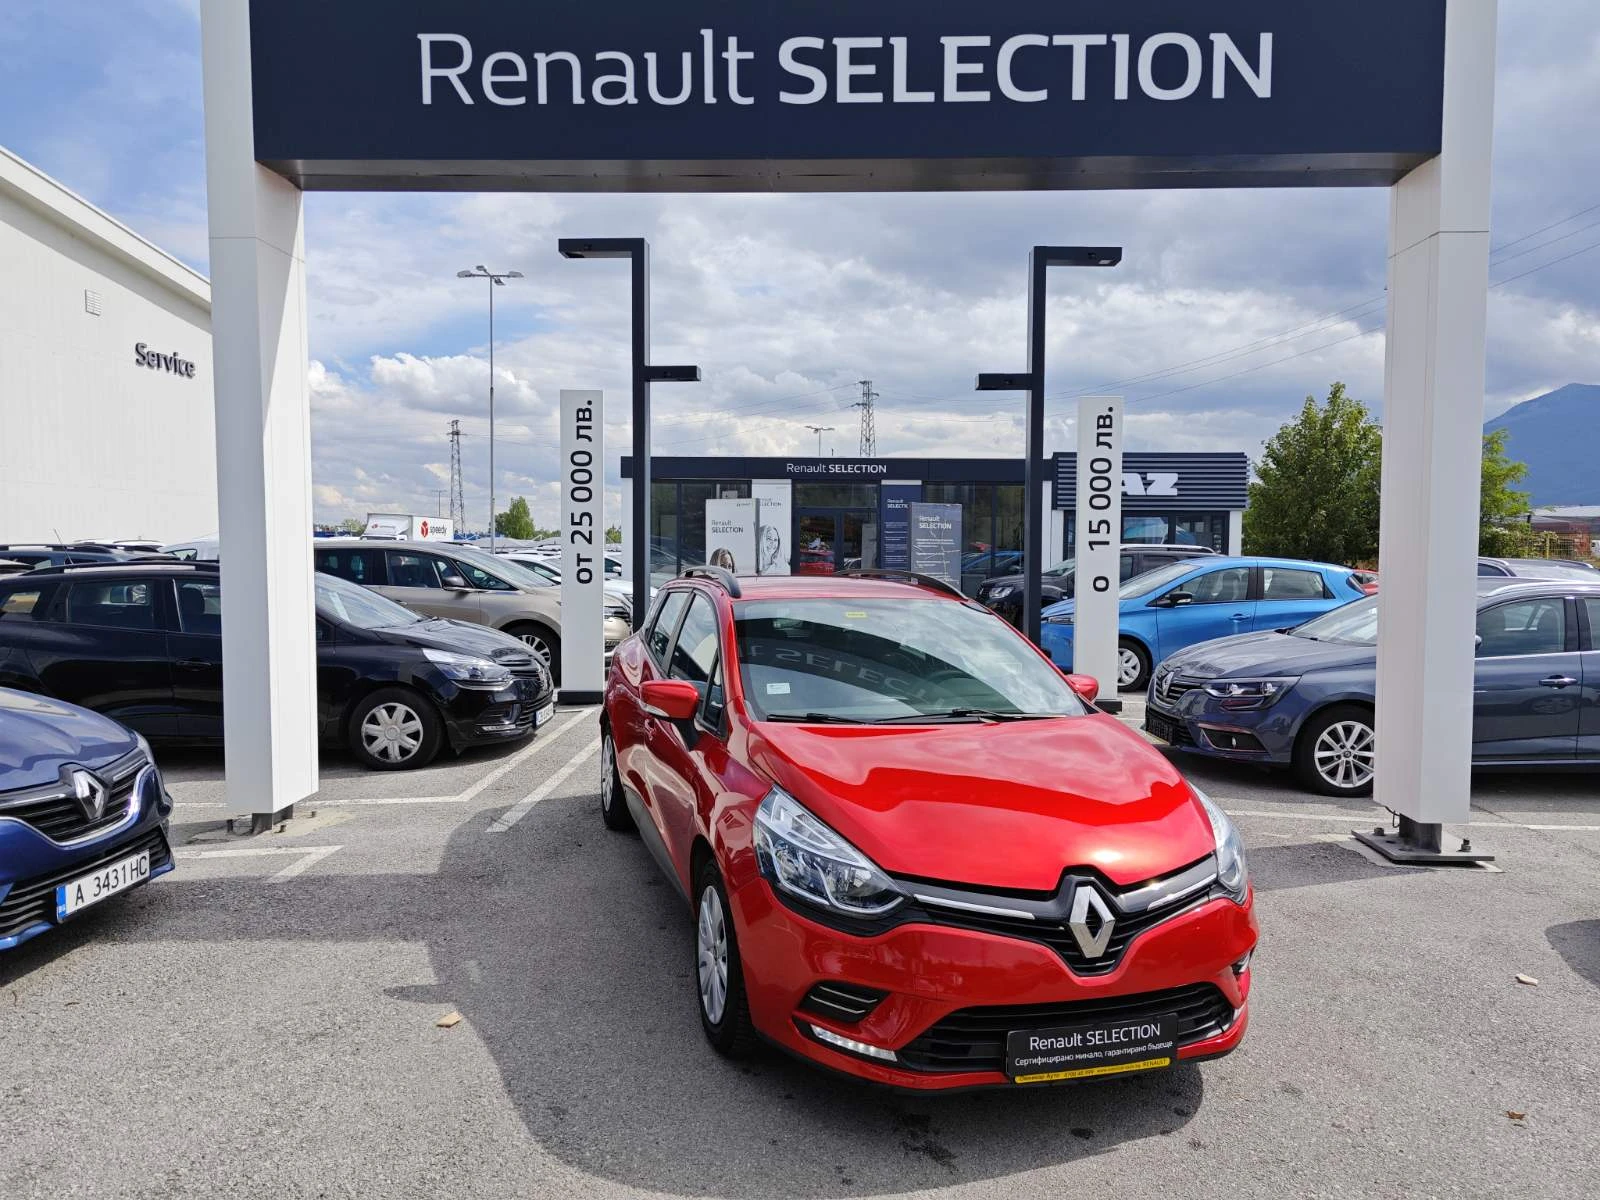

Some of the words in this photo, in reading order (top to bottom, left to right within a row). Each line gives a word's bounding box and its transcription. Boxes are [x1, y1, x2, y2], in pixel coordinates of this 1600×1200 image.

[417, 28, 754, 105] Renault
[777, 31, 1274, 104] SELECTION
[135, 342, 196, 379] Service
[576, 399, 593, 442] лв.
[1095, 406, 1113, 449] лв.
[570, 450, 593, 503] 000
[786, 463, 827, 473] Renault
[828, 464, 887, 474] SELECTION
[1088, 457, 1112, 511] 000
[1121, 472, 1178, 496] AZ
[430, 525, 448, 536] speedy
[570, 511, 593, 545] 25
[711, 526, 744, 534] SELECTION
[919, 522, 952, 530] SELECTION
[1088, 519, 1111, 551] 15
[576, 553, 593, 585] от
[75, 883, 85, 906] A
[1015, 1054, 1074, 1067] Сертифицирано
[1104, 1045, 1147, 1057] гарантирано
[1147, 1039, 1173, 1050] бъдеще
[1029, 1032, 1083, 1051] Renault
[1086, 1023, 1161, 1046] SELECTION
